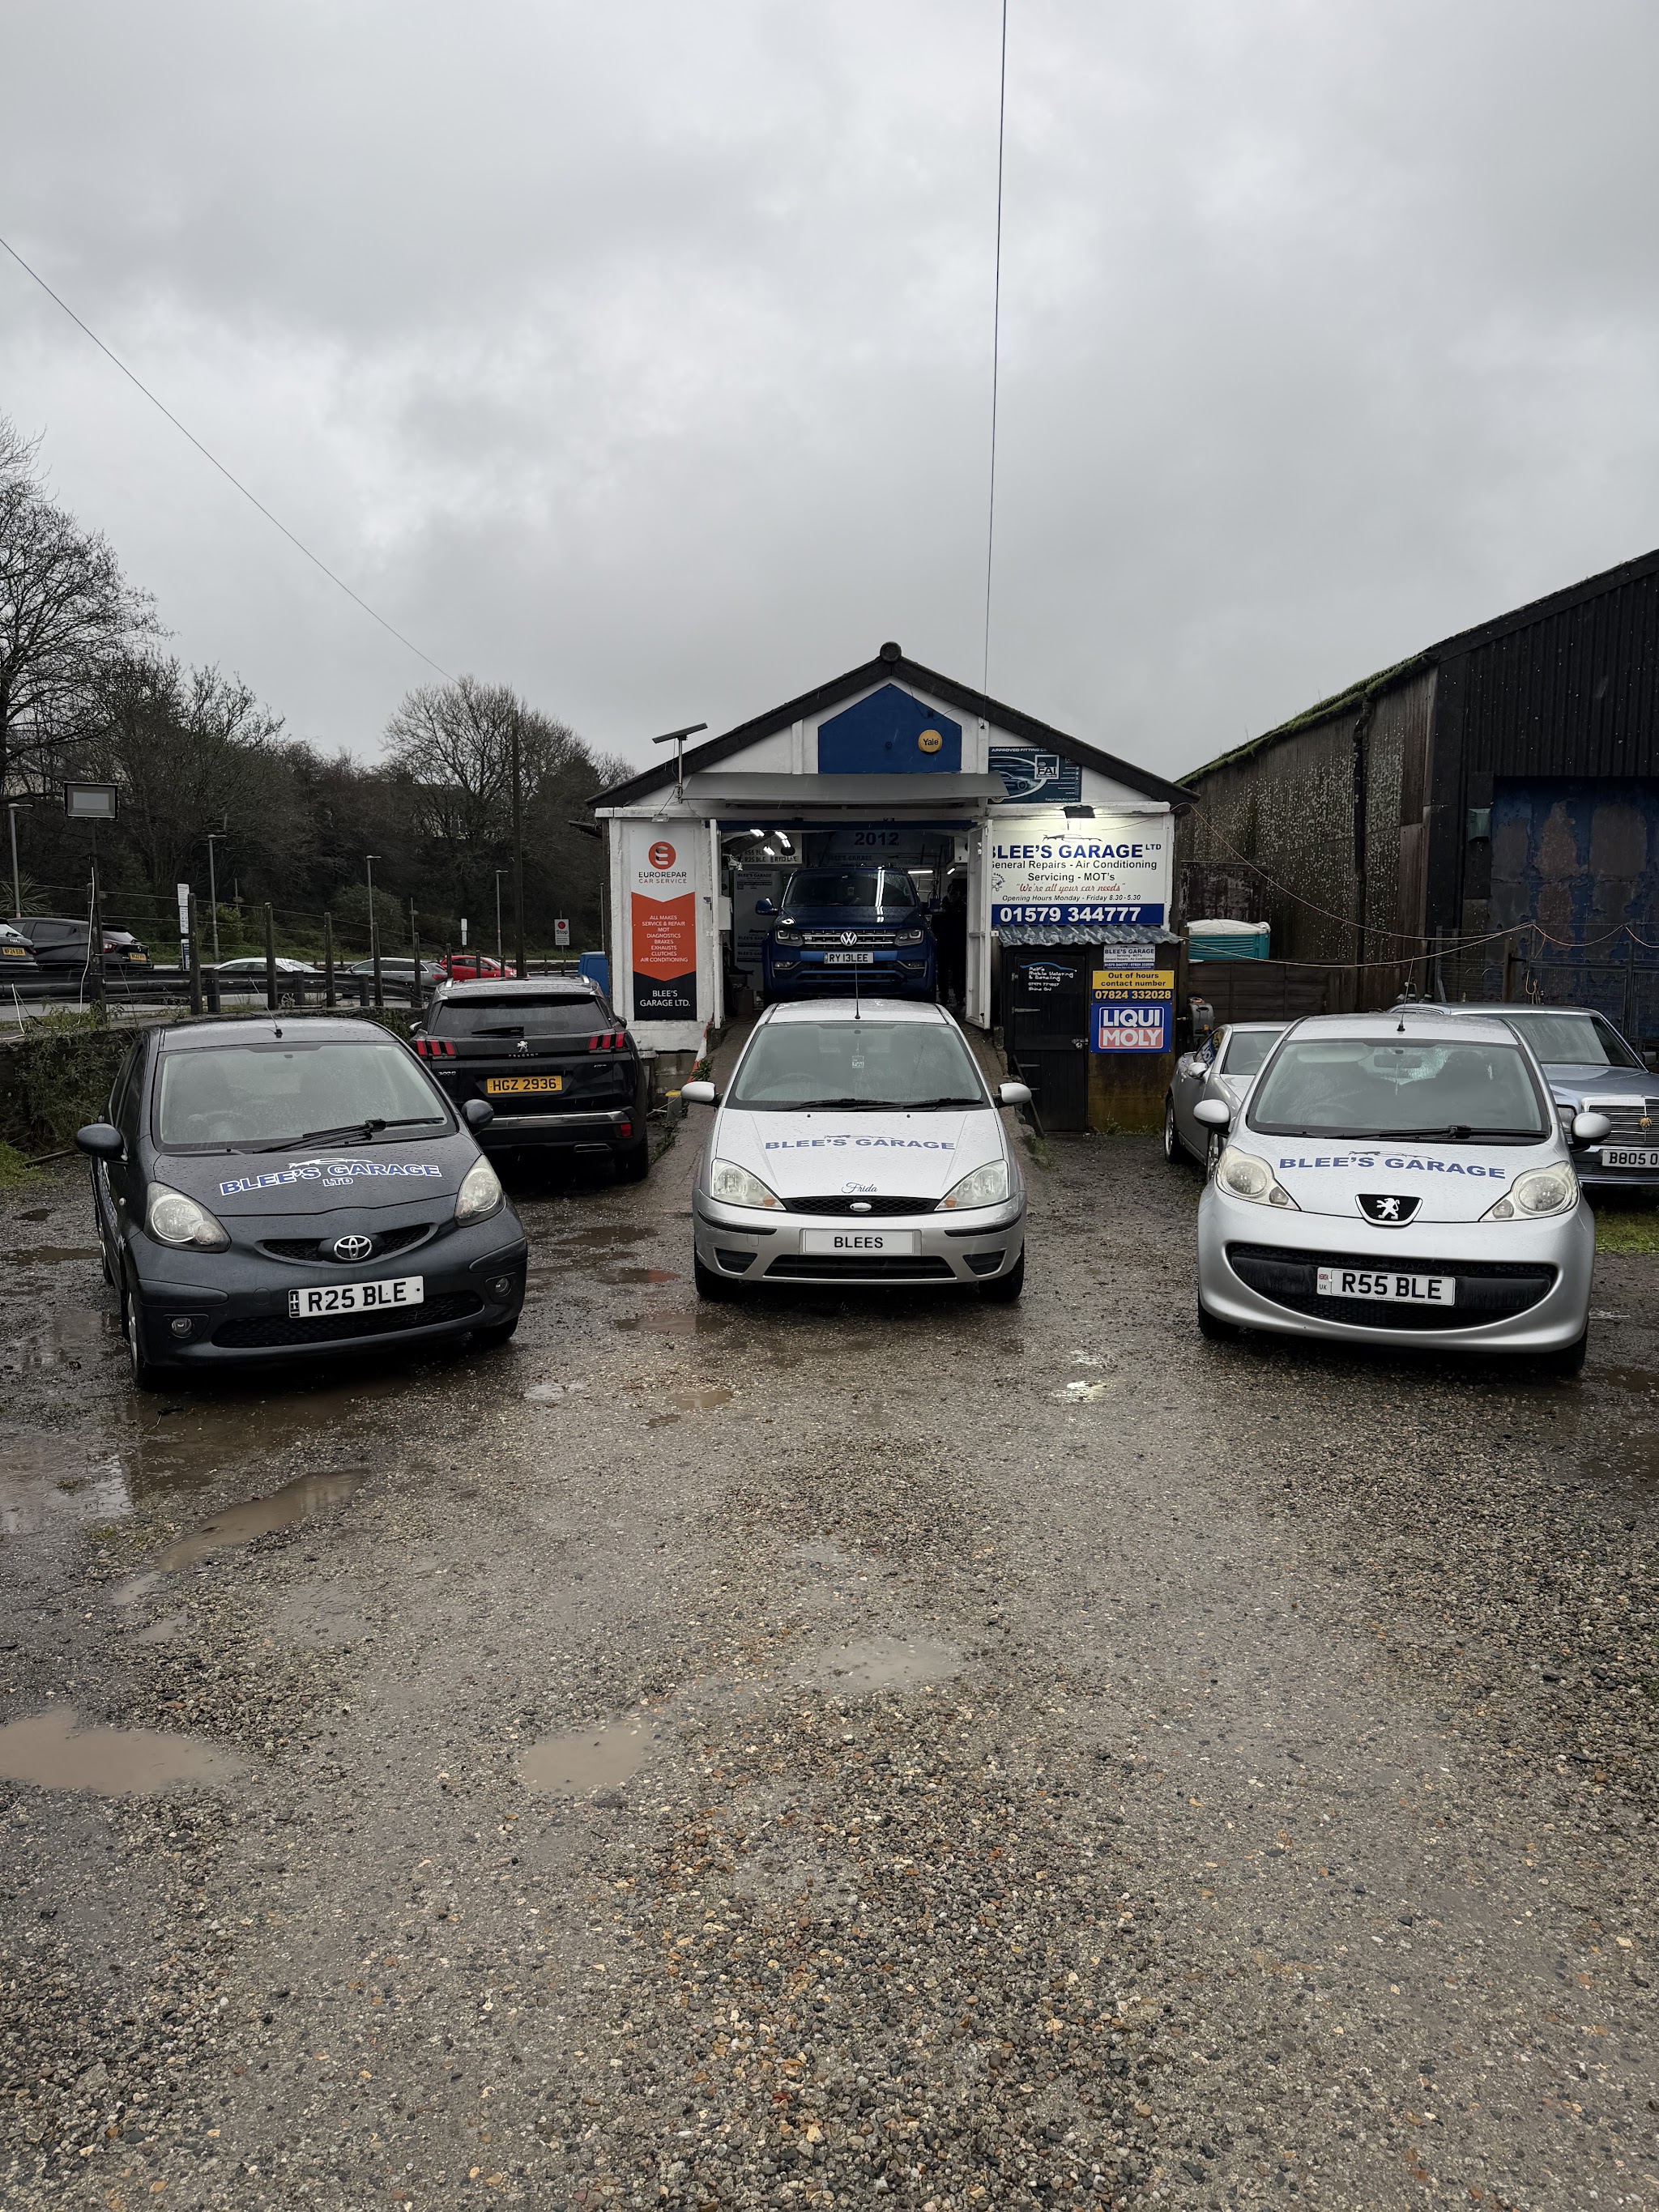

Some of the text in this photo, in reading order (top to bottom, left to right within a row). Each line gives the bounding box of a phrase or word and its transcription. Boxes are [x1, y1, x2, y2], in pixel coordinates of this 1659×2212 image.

[923, 738, 939, 746] Yale
[1037, 767, 1056, 775] FAI
[854, 832, 899, 846] 2012
[1058, 844, 1143, 859] GARAGE
[1028, 860, 1067, 871] Repairs
[1075, 860, 1090, 869] Air
[1093, 859, 1158, 871] Conditioning
[1027, 872, 1074, 883] Servicing
[1084, 872, 1115, 881] MOT's
[1044, 883, 1057, 892] all
[1059, 884, 1079, 894] your
[1054, 894, 1081, 902] Monday
[1086, 894, 1107, 902] Friday
[1000, 906, 1141, 923] 01579 344777
[829, 953, 841, 962] RY
[1094, 990, 1171, 999] 07824 332028
[639, 999, 691, 1007] GARAGE LTD.
[1103, 1008, 1160, 1028] LIQUI
[1102, 1029, 1162, 1046] MOLY
[493, 1078, 557, 1092] HGZ 2936
[765, 1138, 956, 1150] BLEE'S GARAGE
[1609, 1152, 1646, 1166] B805
[1279, 1157, 1506, 1179] BLEE'S GARAGE
[219, 1163, 442, 1196] BLEE'S GARAGE
[322, 1177, 354, 1187] LTD
[841, 1182, 878, 1194] Frida
[834, 1236, 884, 1248] BLEES
[1341, 1272, 1443, 1300] R55 BLE
[308, 1281, 407, 1312] R25 BLE
